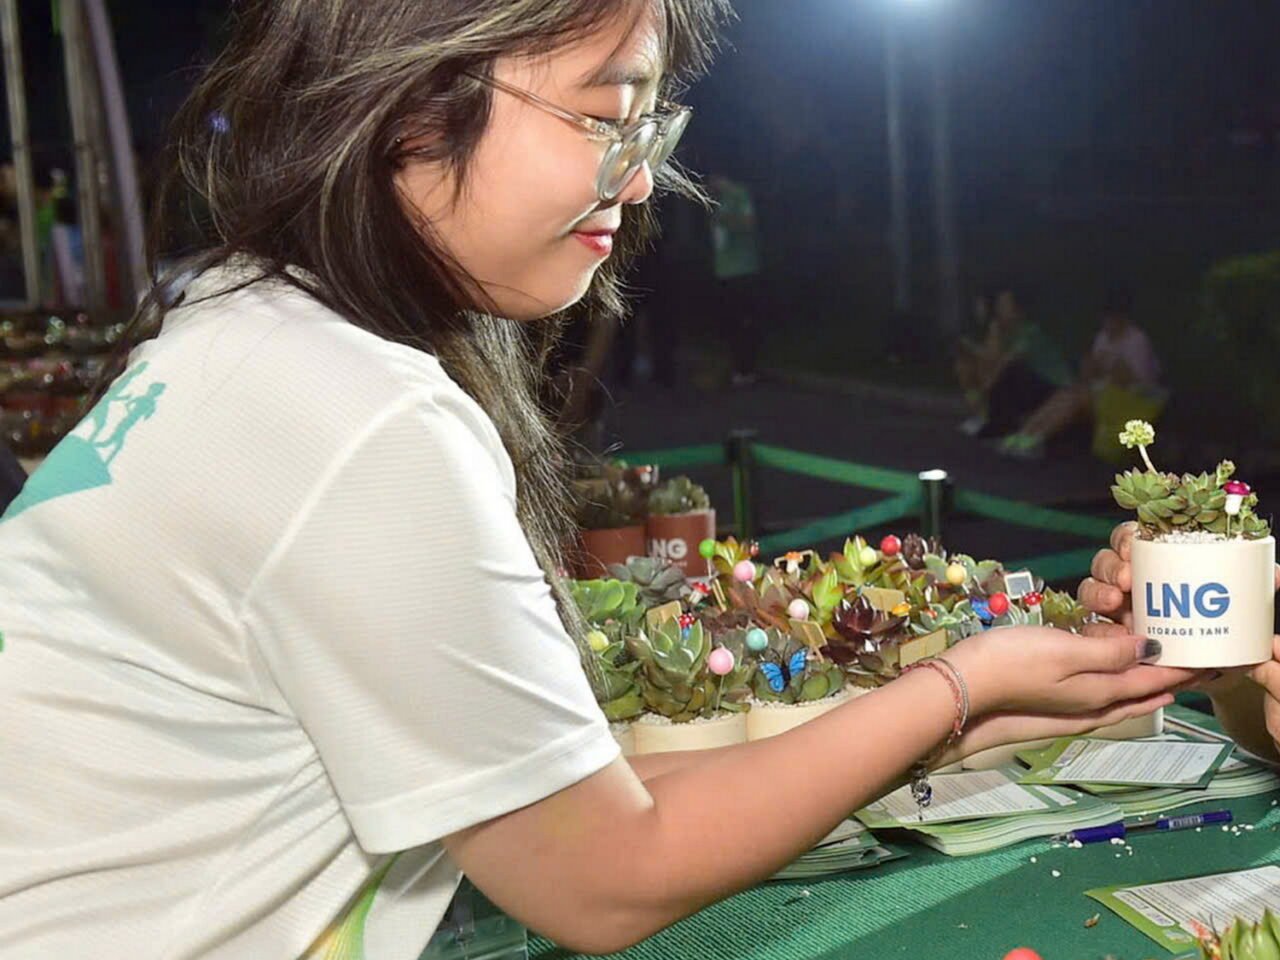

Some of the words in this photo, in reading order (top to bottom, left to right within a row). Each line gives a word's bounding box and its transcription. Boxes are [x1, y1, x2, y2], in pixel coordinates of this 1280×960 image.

[1146, 582, 1231, 618] LNG
[1147, 626, 1193, 636] STORAGE
[1200, 626, 1230, 636] TANK
